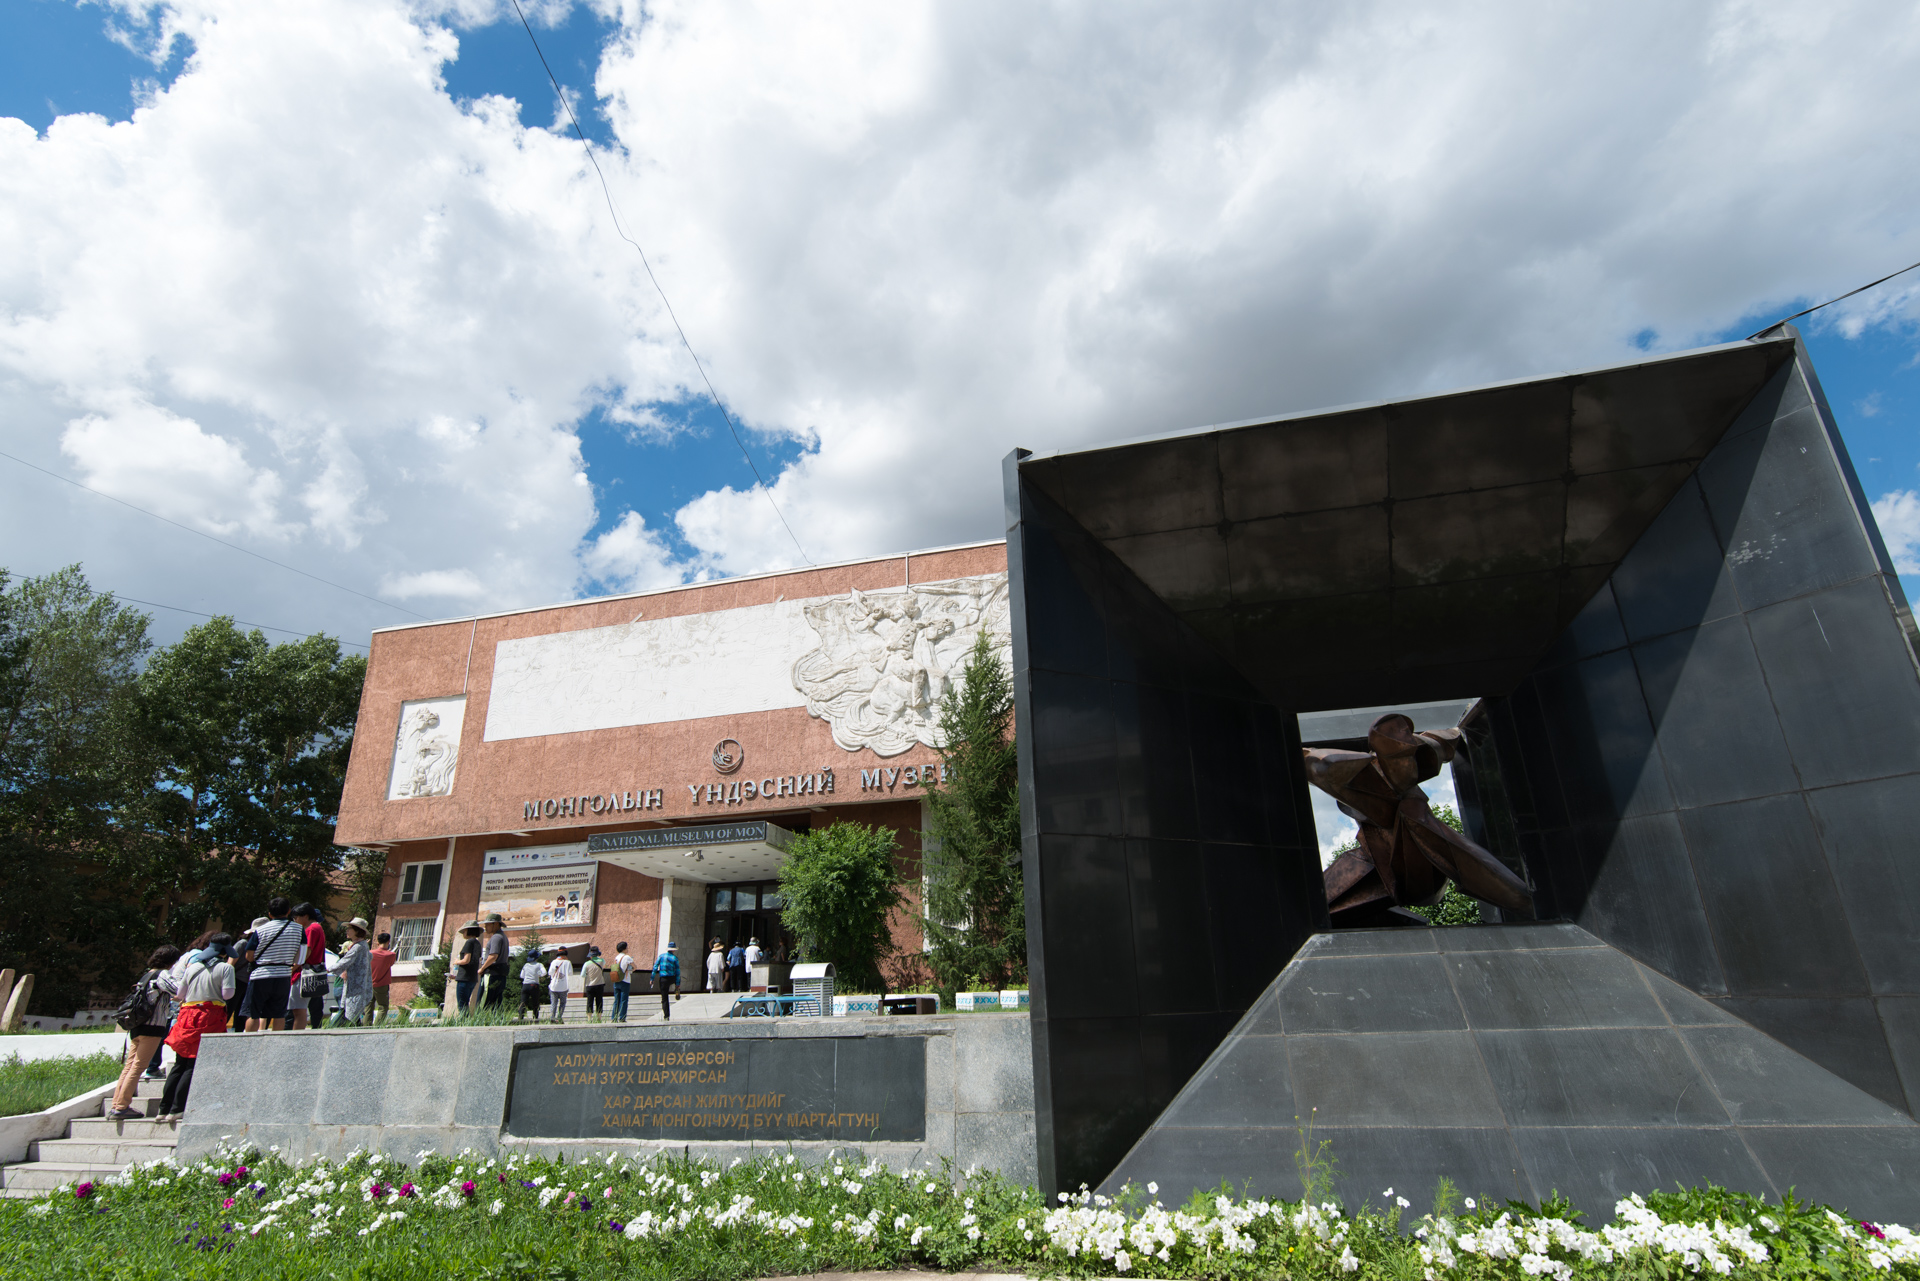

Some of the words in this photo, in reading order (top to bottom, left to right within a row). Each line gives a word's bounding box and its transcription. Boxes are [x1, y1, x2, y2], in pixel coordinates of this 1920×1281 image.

[522, 788, 663, 819] МОНГОЛЫН
[687, 765, 835, 805] ҮНДЭСНИЙ
[602, 831, 661, 847] NATIONAL
[662, 829, 715, 843] MUSEUM
[716, 827, 733, 839] OF
[735, 826, 765, 838] MON
[555, 1054, 606, 1067] ХАЛУУН
[610, 1053, 653, 1066] ИТГЭЛ
[657, 1051, 735, 1068] ЦӨХӨРСӨН
[553, 1072, 597, 1085] ХАТАН
[600, 1071, 634, 1084] ЗҮРХ
[638, 1070, 727, 1084] ШАРХИРСАН
[603, 1095, 631, 1108] ХАР
[634, 1095, 692, 1110] ДАРСАН
[693, 1091, 786, 1110] ЖИЛҮҮДИЙГ
[601, 1114, 649, 1128] ХАМАГ
[652, 1113, 750, 1130] МОНГОЛЧУУД
[753, 1113, 783, 1127] БҮҮ
[787, 1113, 880, 1127] МАРТАГТУН!
